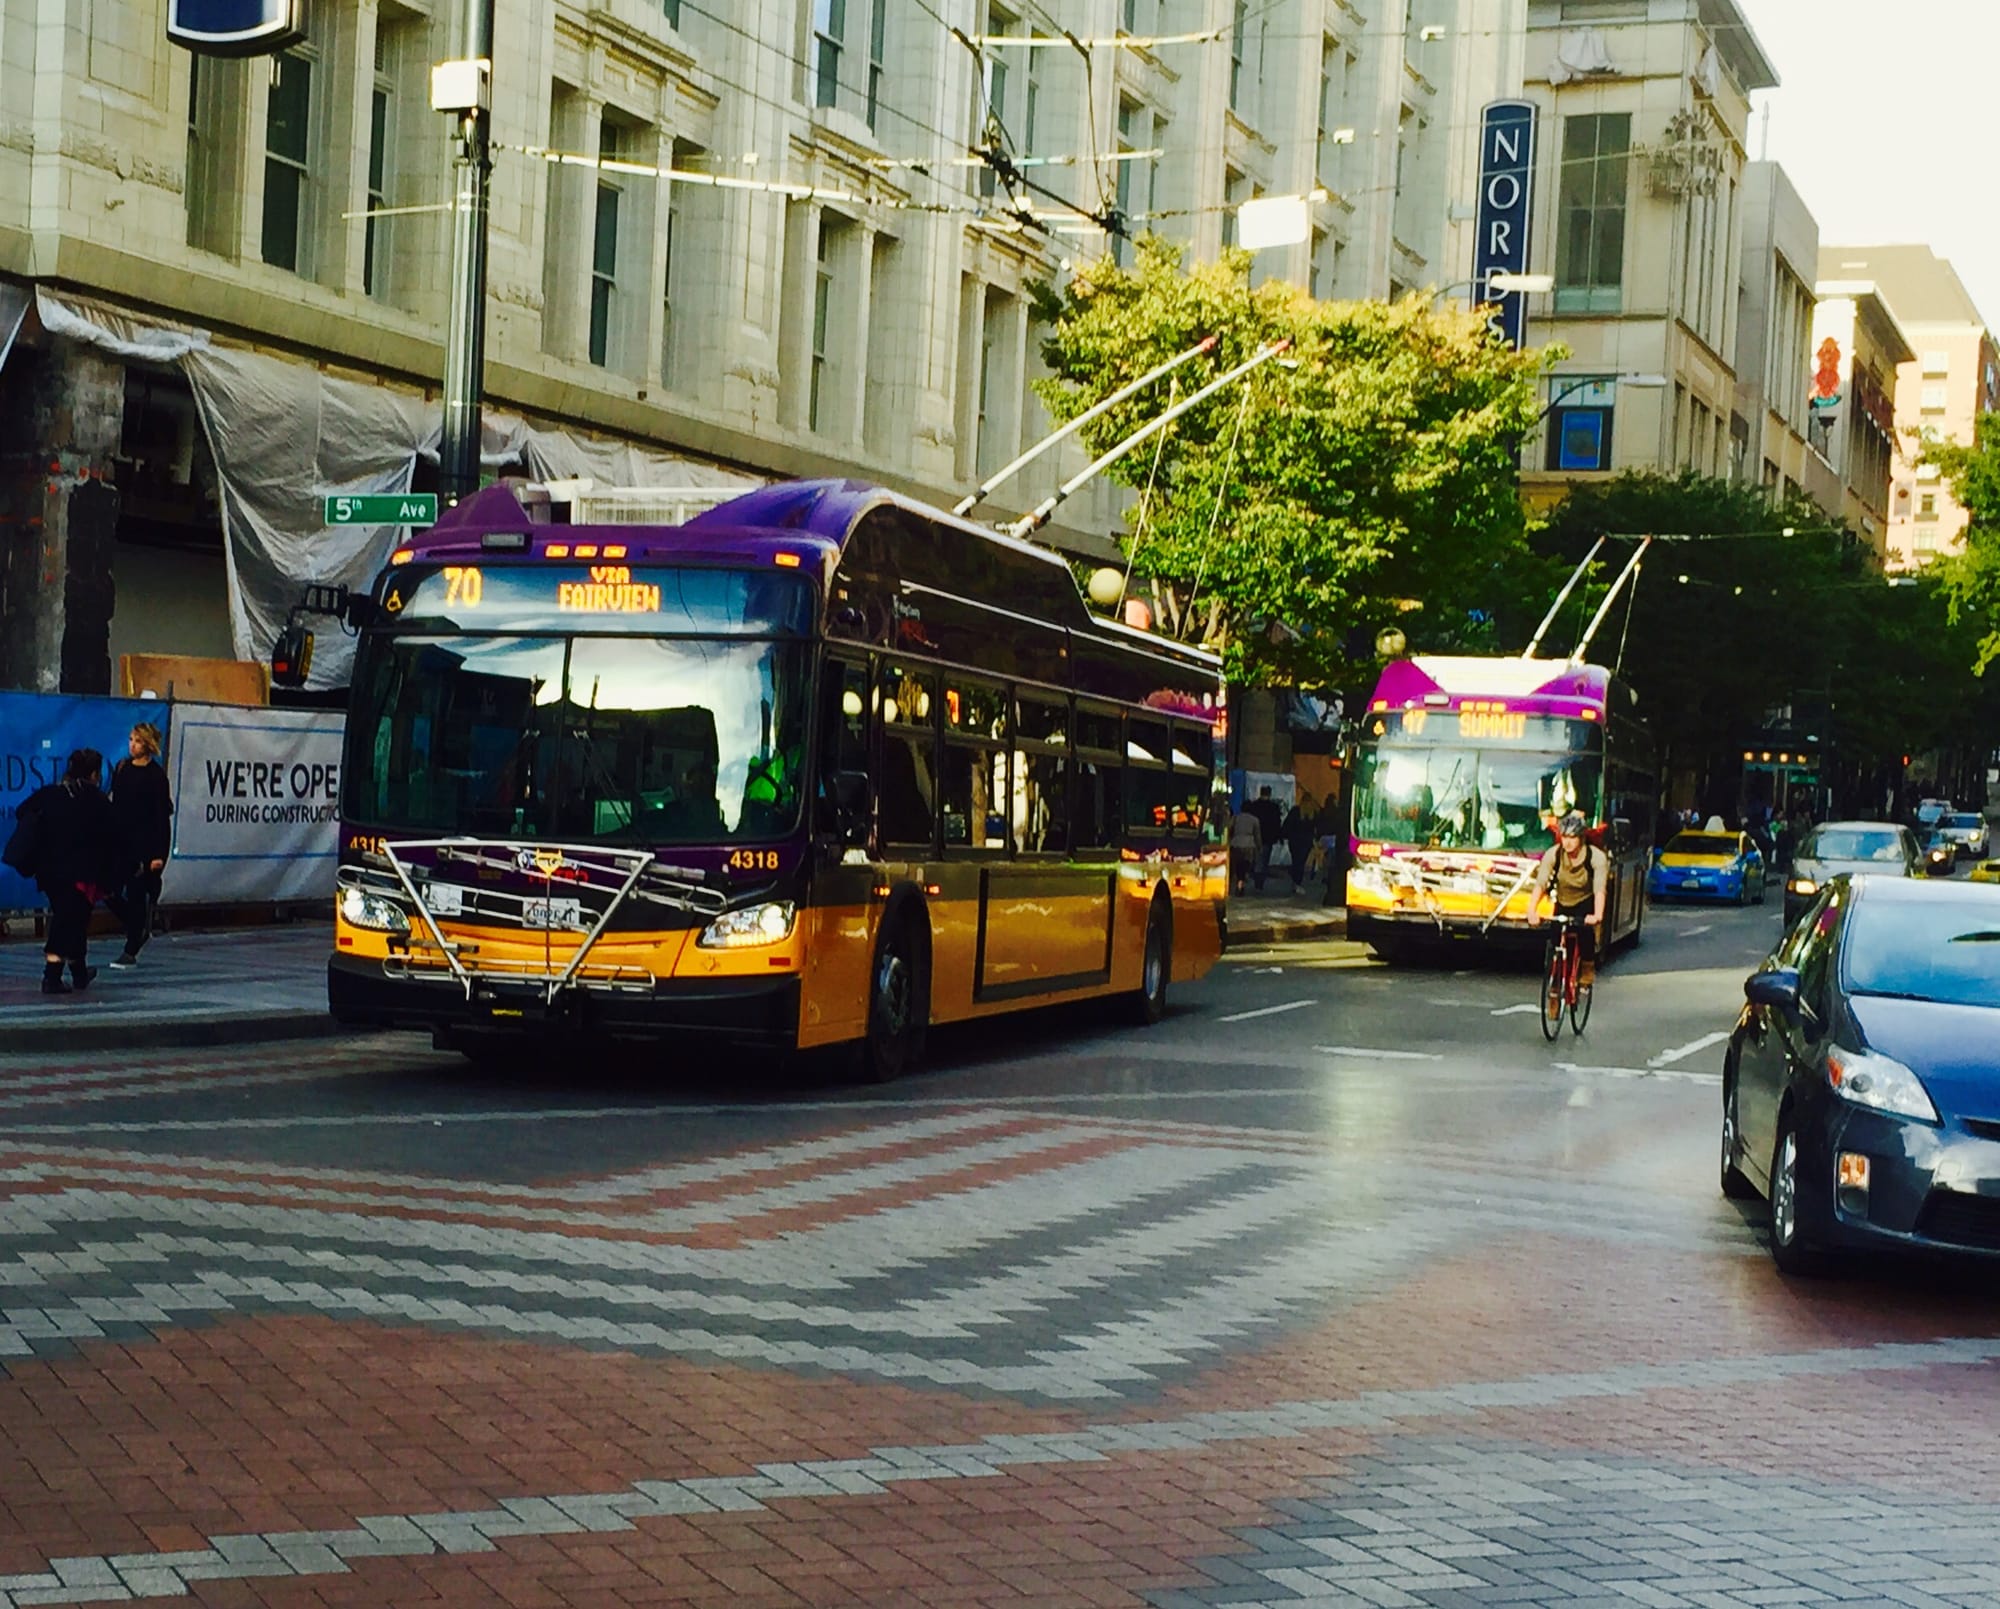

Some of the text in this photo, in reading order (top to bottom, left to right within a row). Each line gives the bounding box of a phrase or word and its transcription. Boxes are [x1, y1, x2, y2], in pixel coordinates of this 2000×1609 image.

[336, 498, 426, 520] 5th Ave
[590, 566, 630, 583] VIA
[444, 567, 660, 612] 70 FAIRVIEW
[1459, 713, 1526, 737] SUMMIT
[206, 760, 341, 798] WE'RE OPE
[206, 803, 259, 823] DURING
[730, 851, 778, 869] 4318
